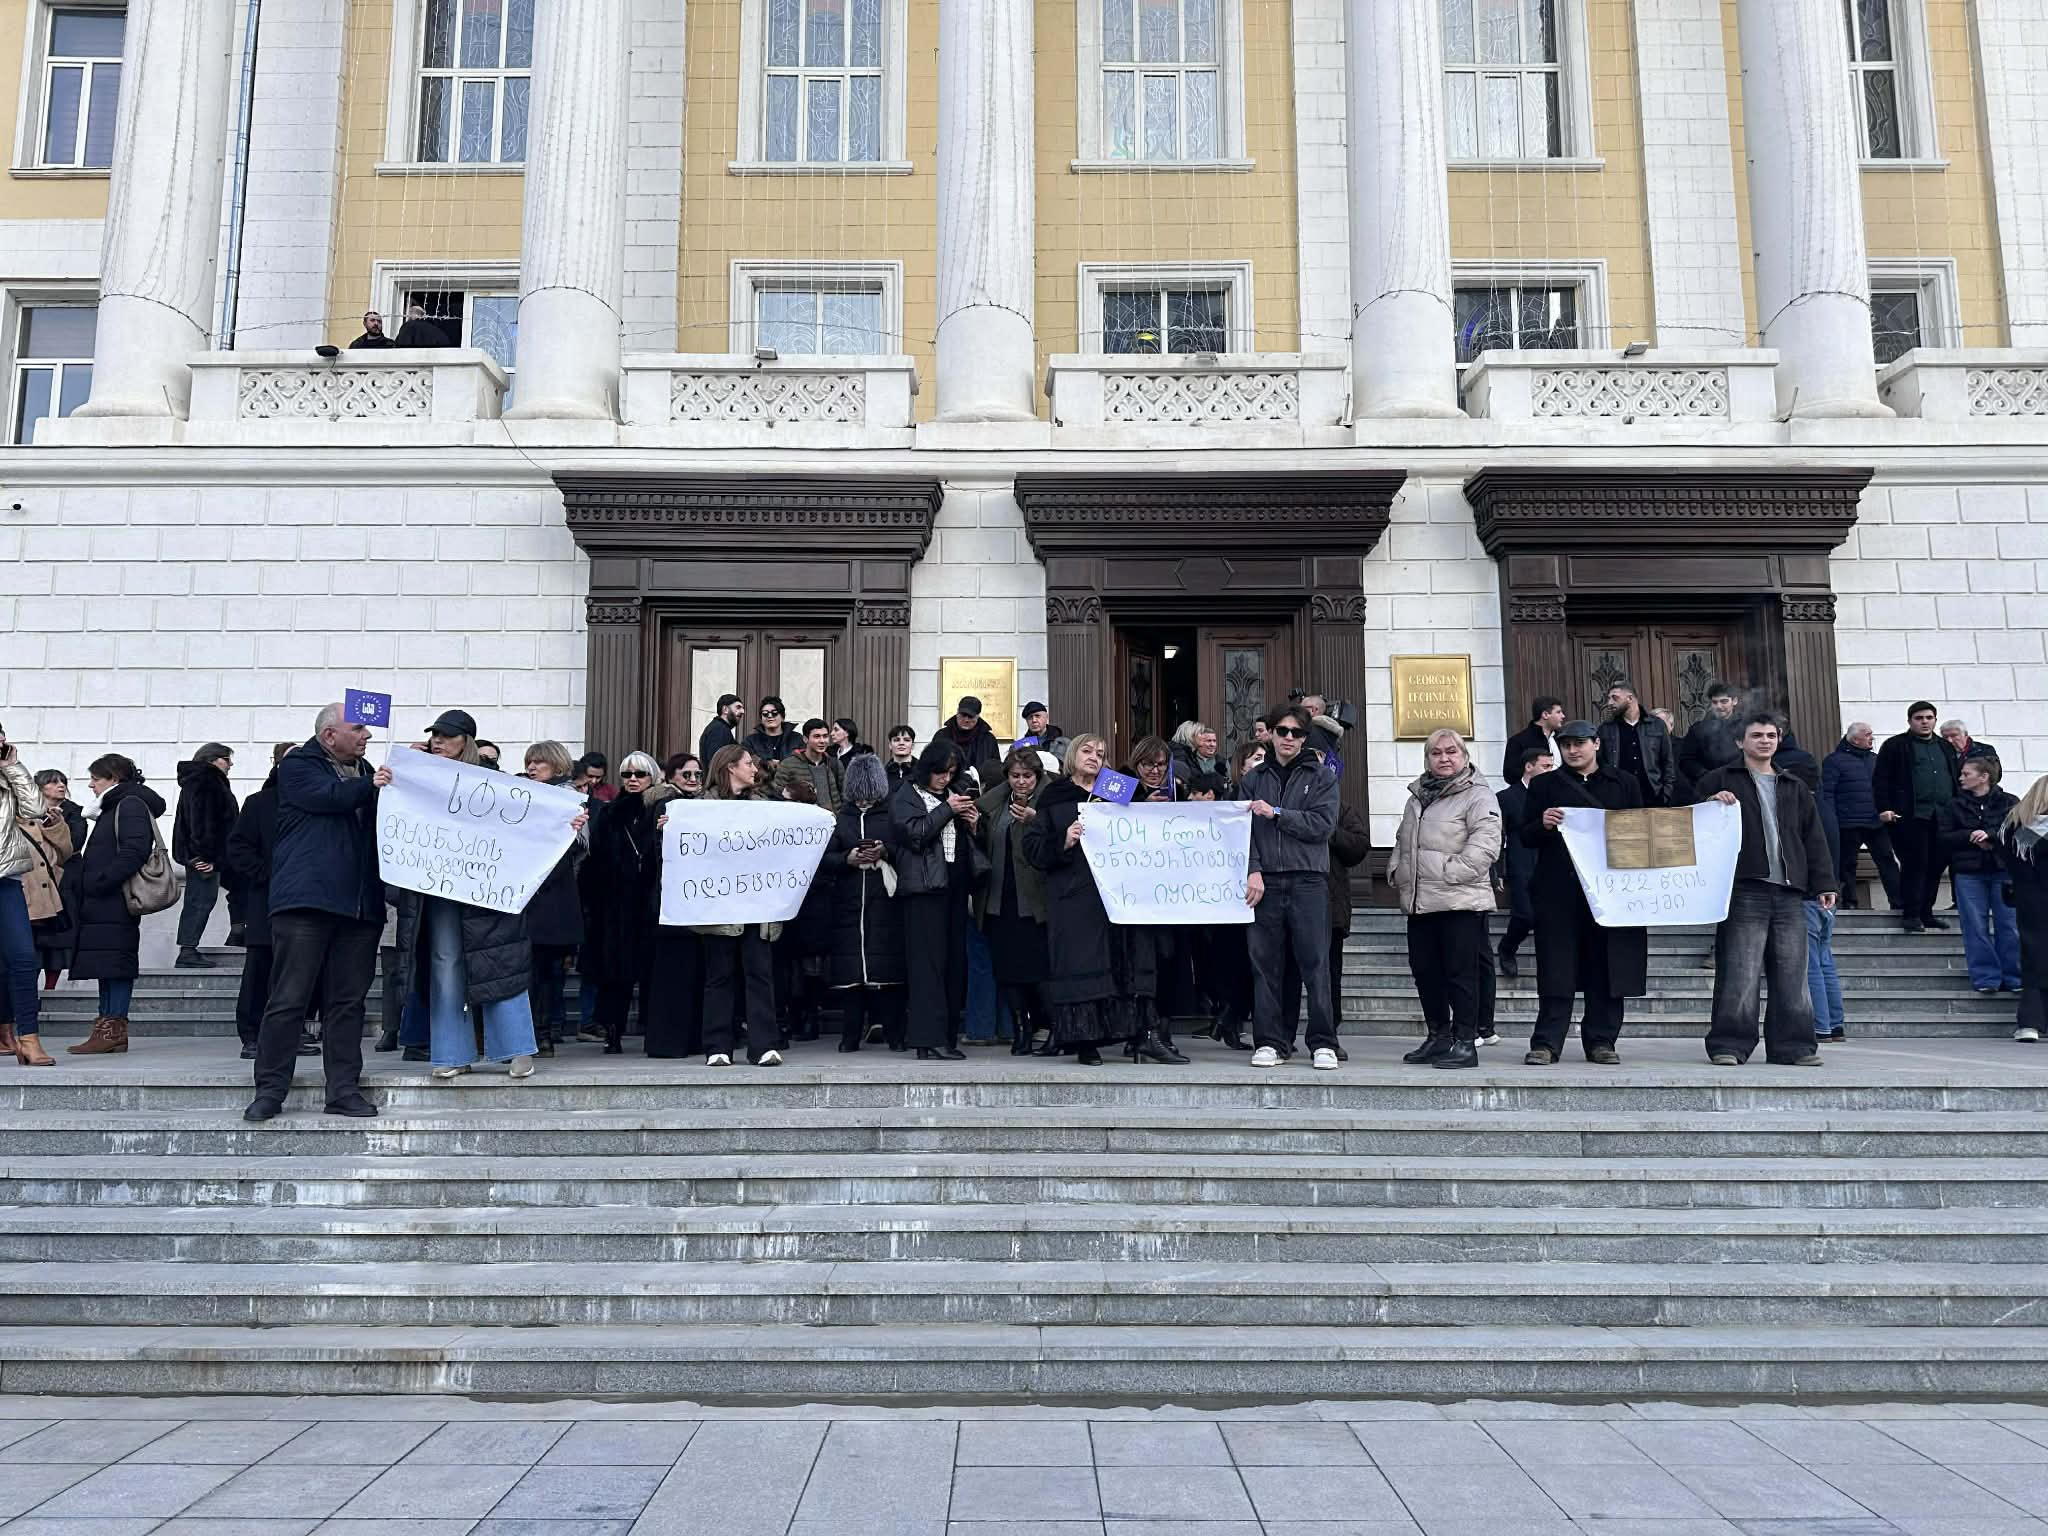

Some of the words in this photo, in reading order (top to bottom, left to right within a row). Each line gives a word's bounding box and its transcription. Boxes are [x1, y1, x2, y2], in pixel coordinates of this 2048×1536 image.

[1408, 674, 1458, 686] GEORGIAN
[448, 772, 531, 824] სტუ
[384, 814, 504, 861] მიქანაძის
[1106, 817, 1146, 847] 104
[1162, 815, 1222, 848] წლის
[679, 832, 707, 856] ნუ
[382, 844, 497, 880] დაარსებული
[1092, 848, 1246, 869] უნივერსიტეტი
[417, 871, 454, 894] არ
[1594, 873, 1652, 895] 1922
[1660, 871, 1706, 890] წლის
